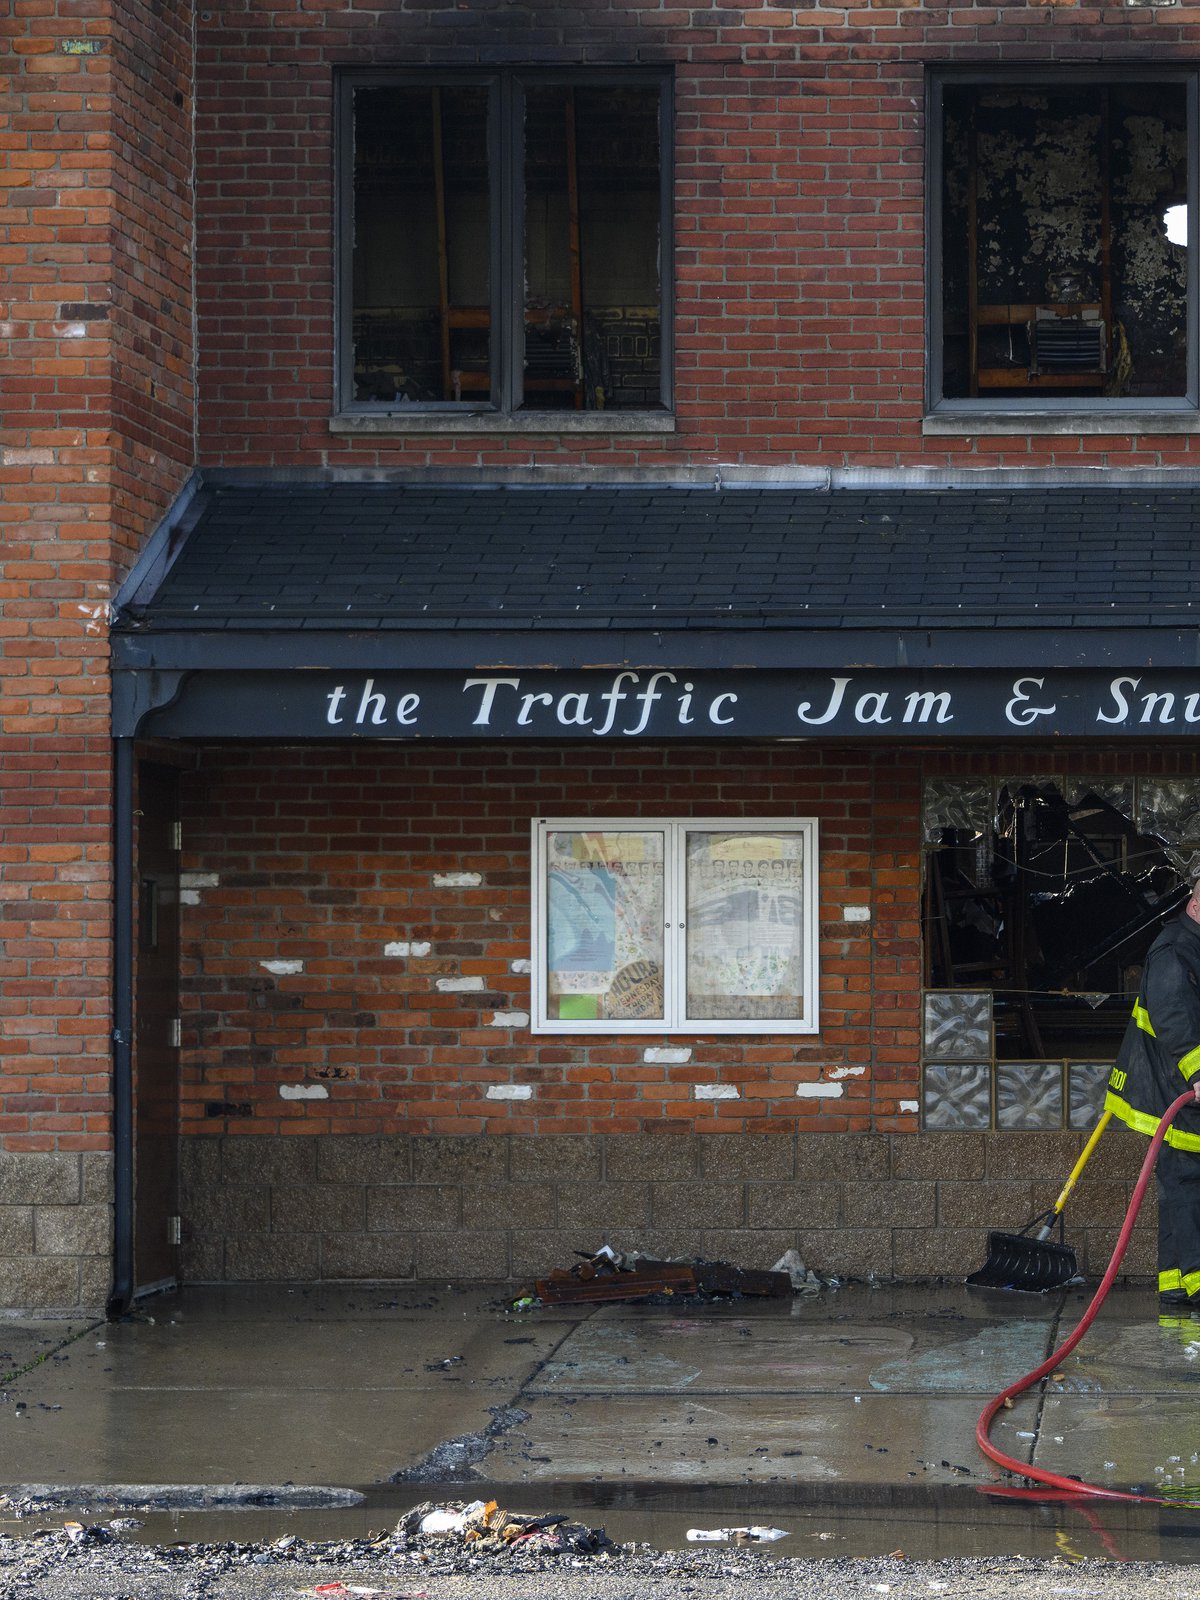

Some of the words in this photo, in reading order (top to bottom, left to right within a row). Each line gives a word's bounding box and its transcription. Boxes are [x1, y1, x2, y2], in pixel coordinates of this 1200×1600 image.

[326, 679, 421, 725] the
[462, 671, 738, 735] Traffic
[797, 677, 954, 725] Jam
[1005, 677, 1057, 726] &
